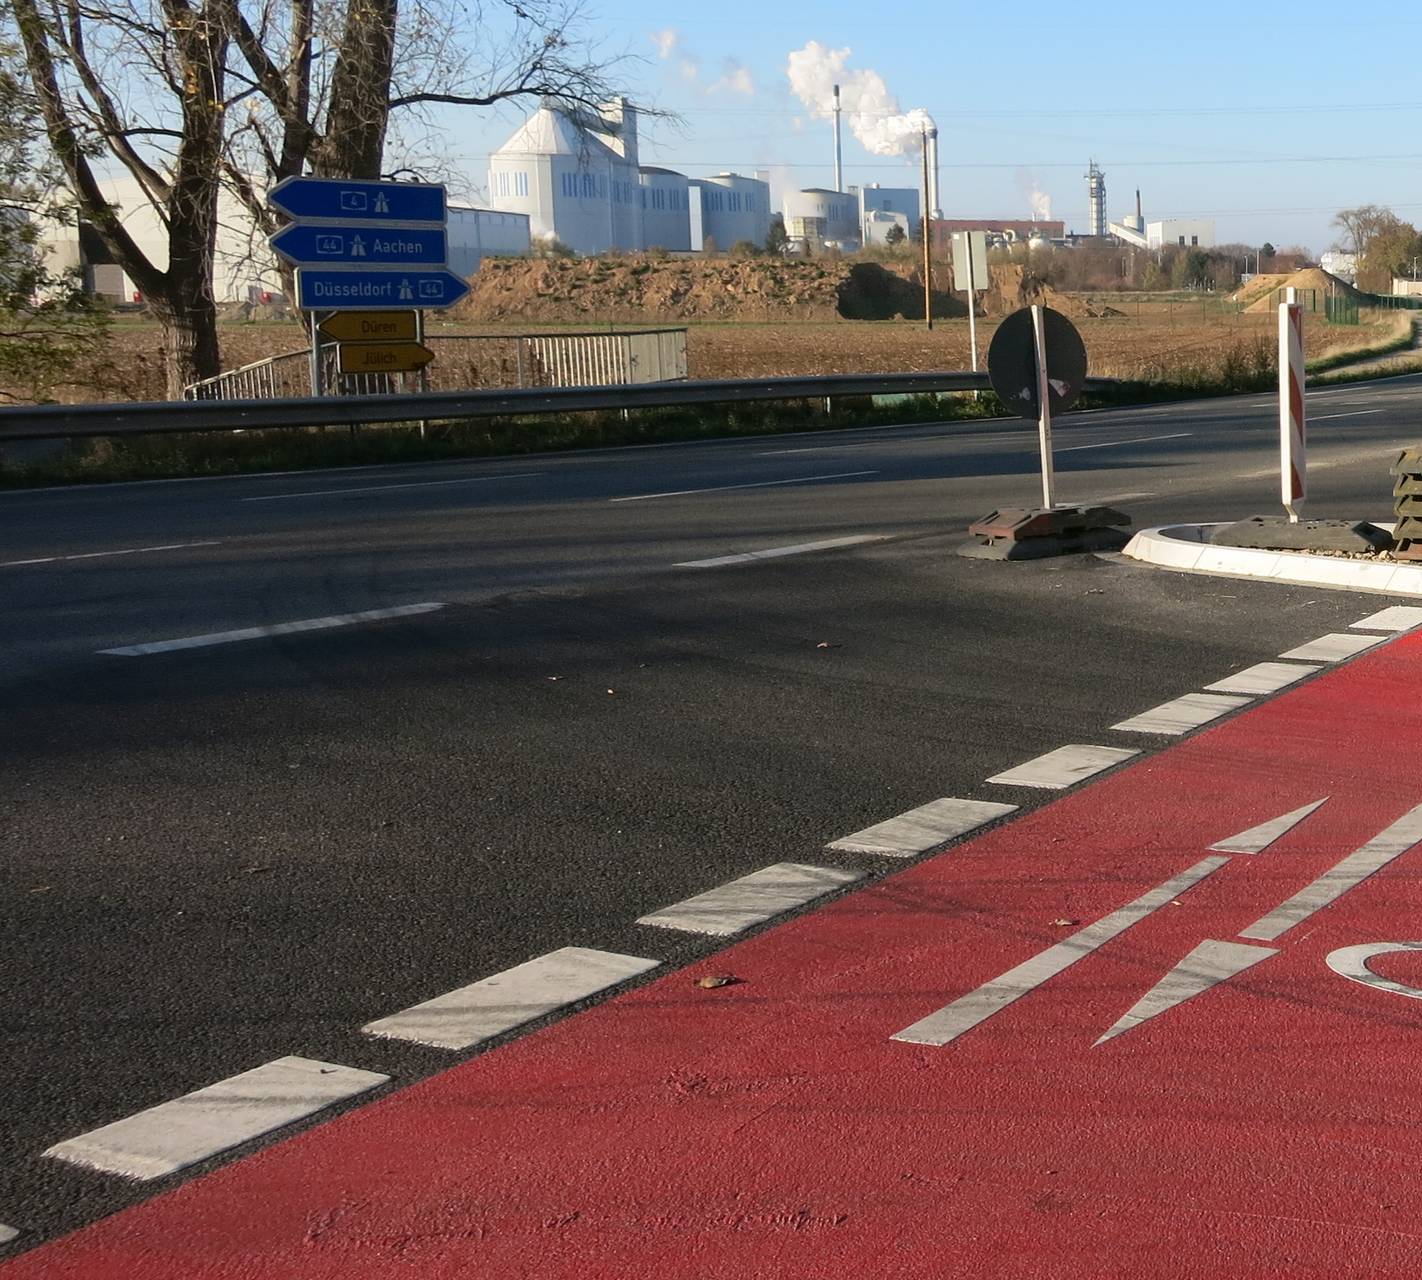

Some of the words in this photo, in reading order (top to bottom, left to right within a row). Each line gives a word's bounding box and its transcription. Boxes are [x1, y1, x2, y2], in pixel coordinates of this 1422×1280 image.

[322, 239, 337, 249] 44
[373, 239, 423, 254] Aachen
[314, 281, 392, 297] Düsseldorf
[425, 283, 438, 294] 44
[361, 320, 397, 333] Düren
[361, 351, 397, 365] Jülich
